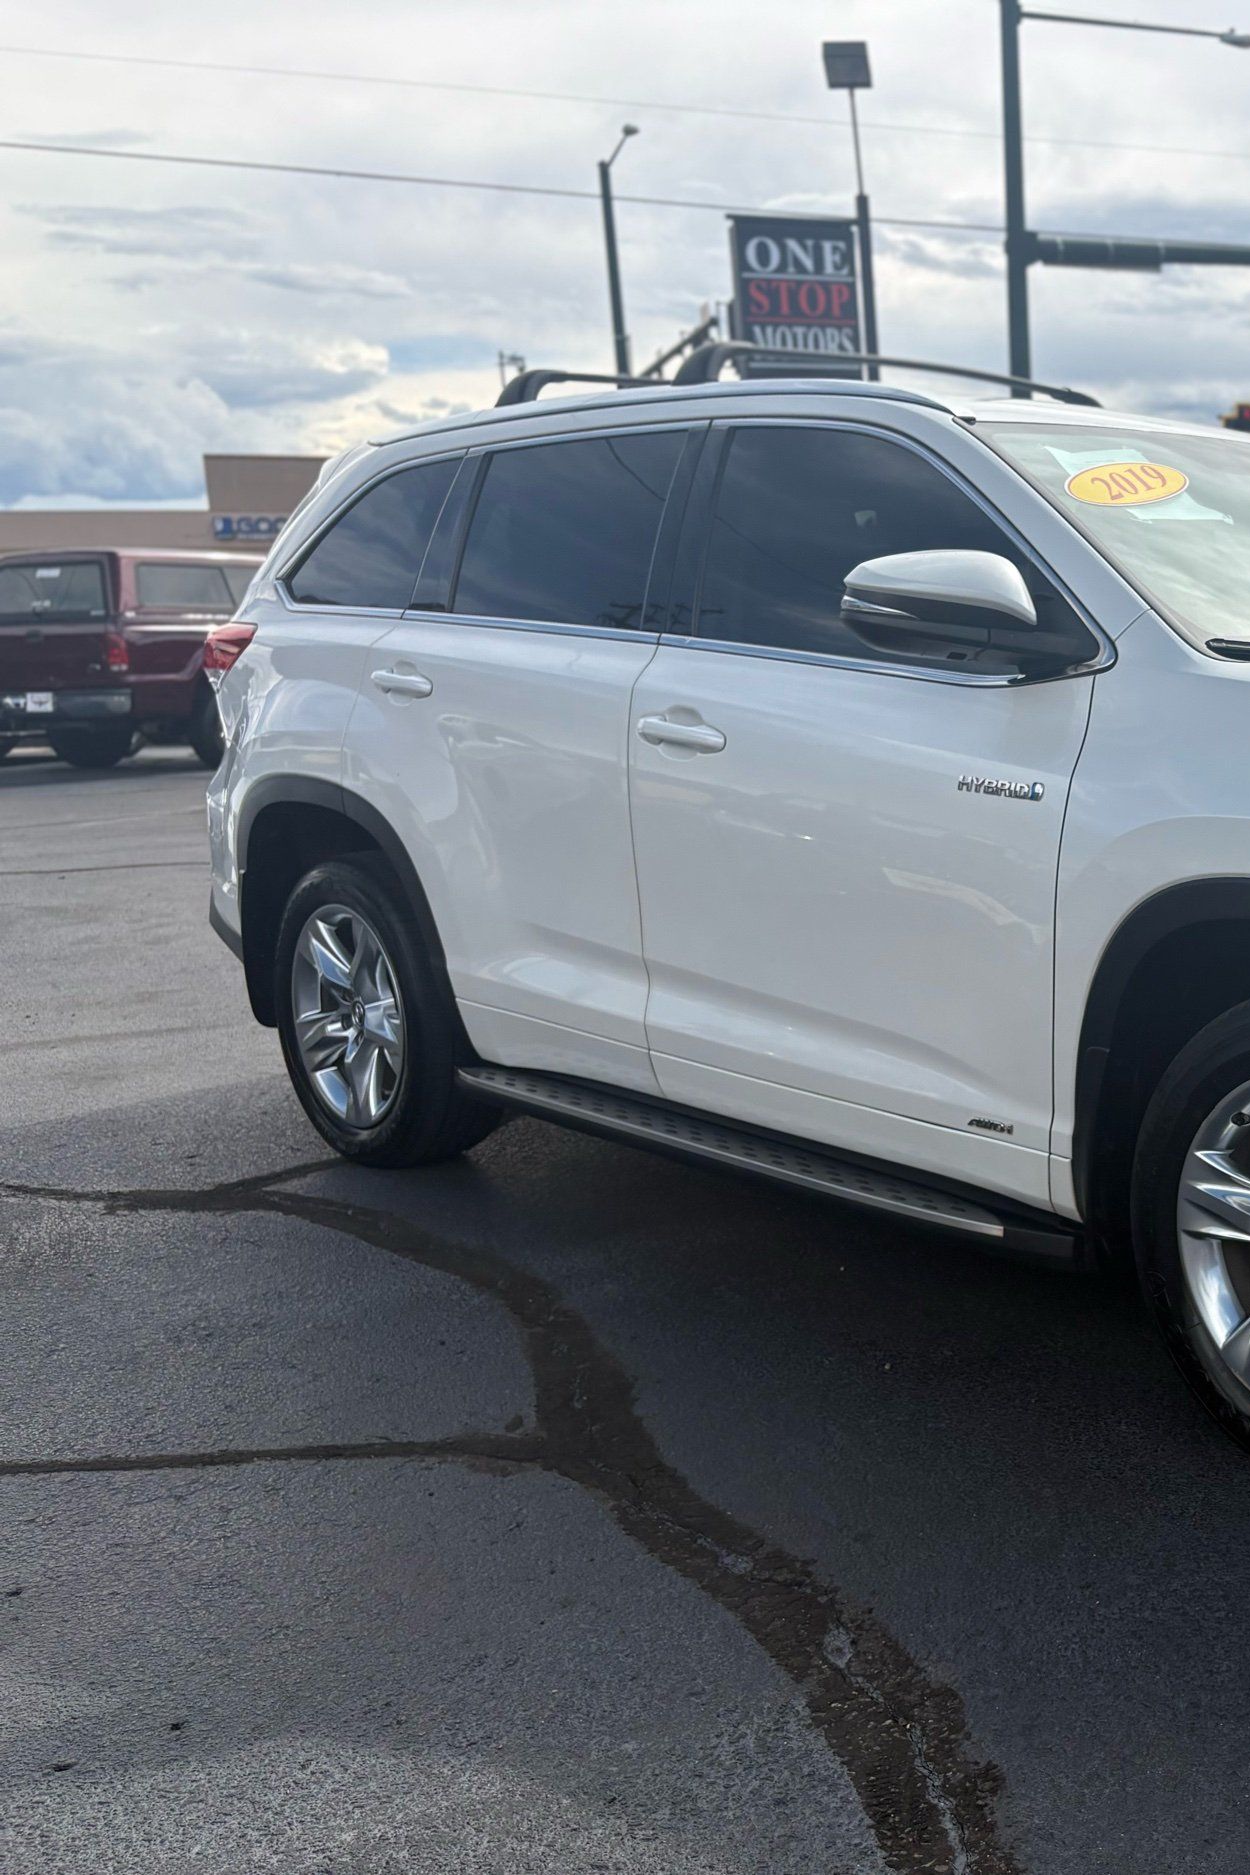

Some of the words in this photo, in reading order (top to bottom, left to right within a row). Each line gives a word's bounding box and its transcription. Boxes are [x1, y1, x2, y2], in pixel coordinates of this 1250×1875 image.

[745, 236, 849, 275] ONE
[748, 279, 850, 317] STOP
[752, 324, 856, 355] MOTORS
[1090, 464, 1167, 501] 2019
[957, 774, 1030, 800] HYBRID
